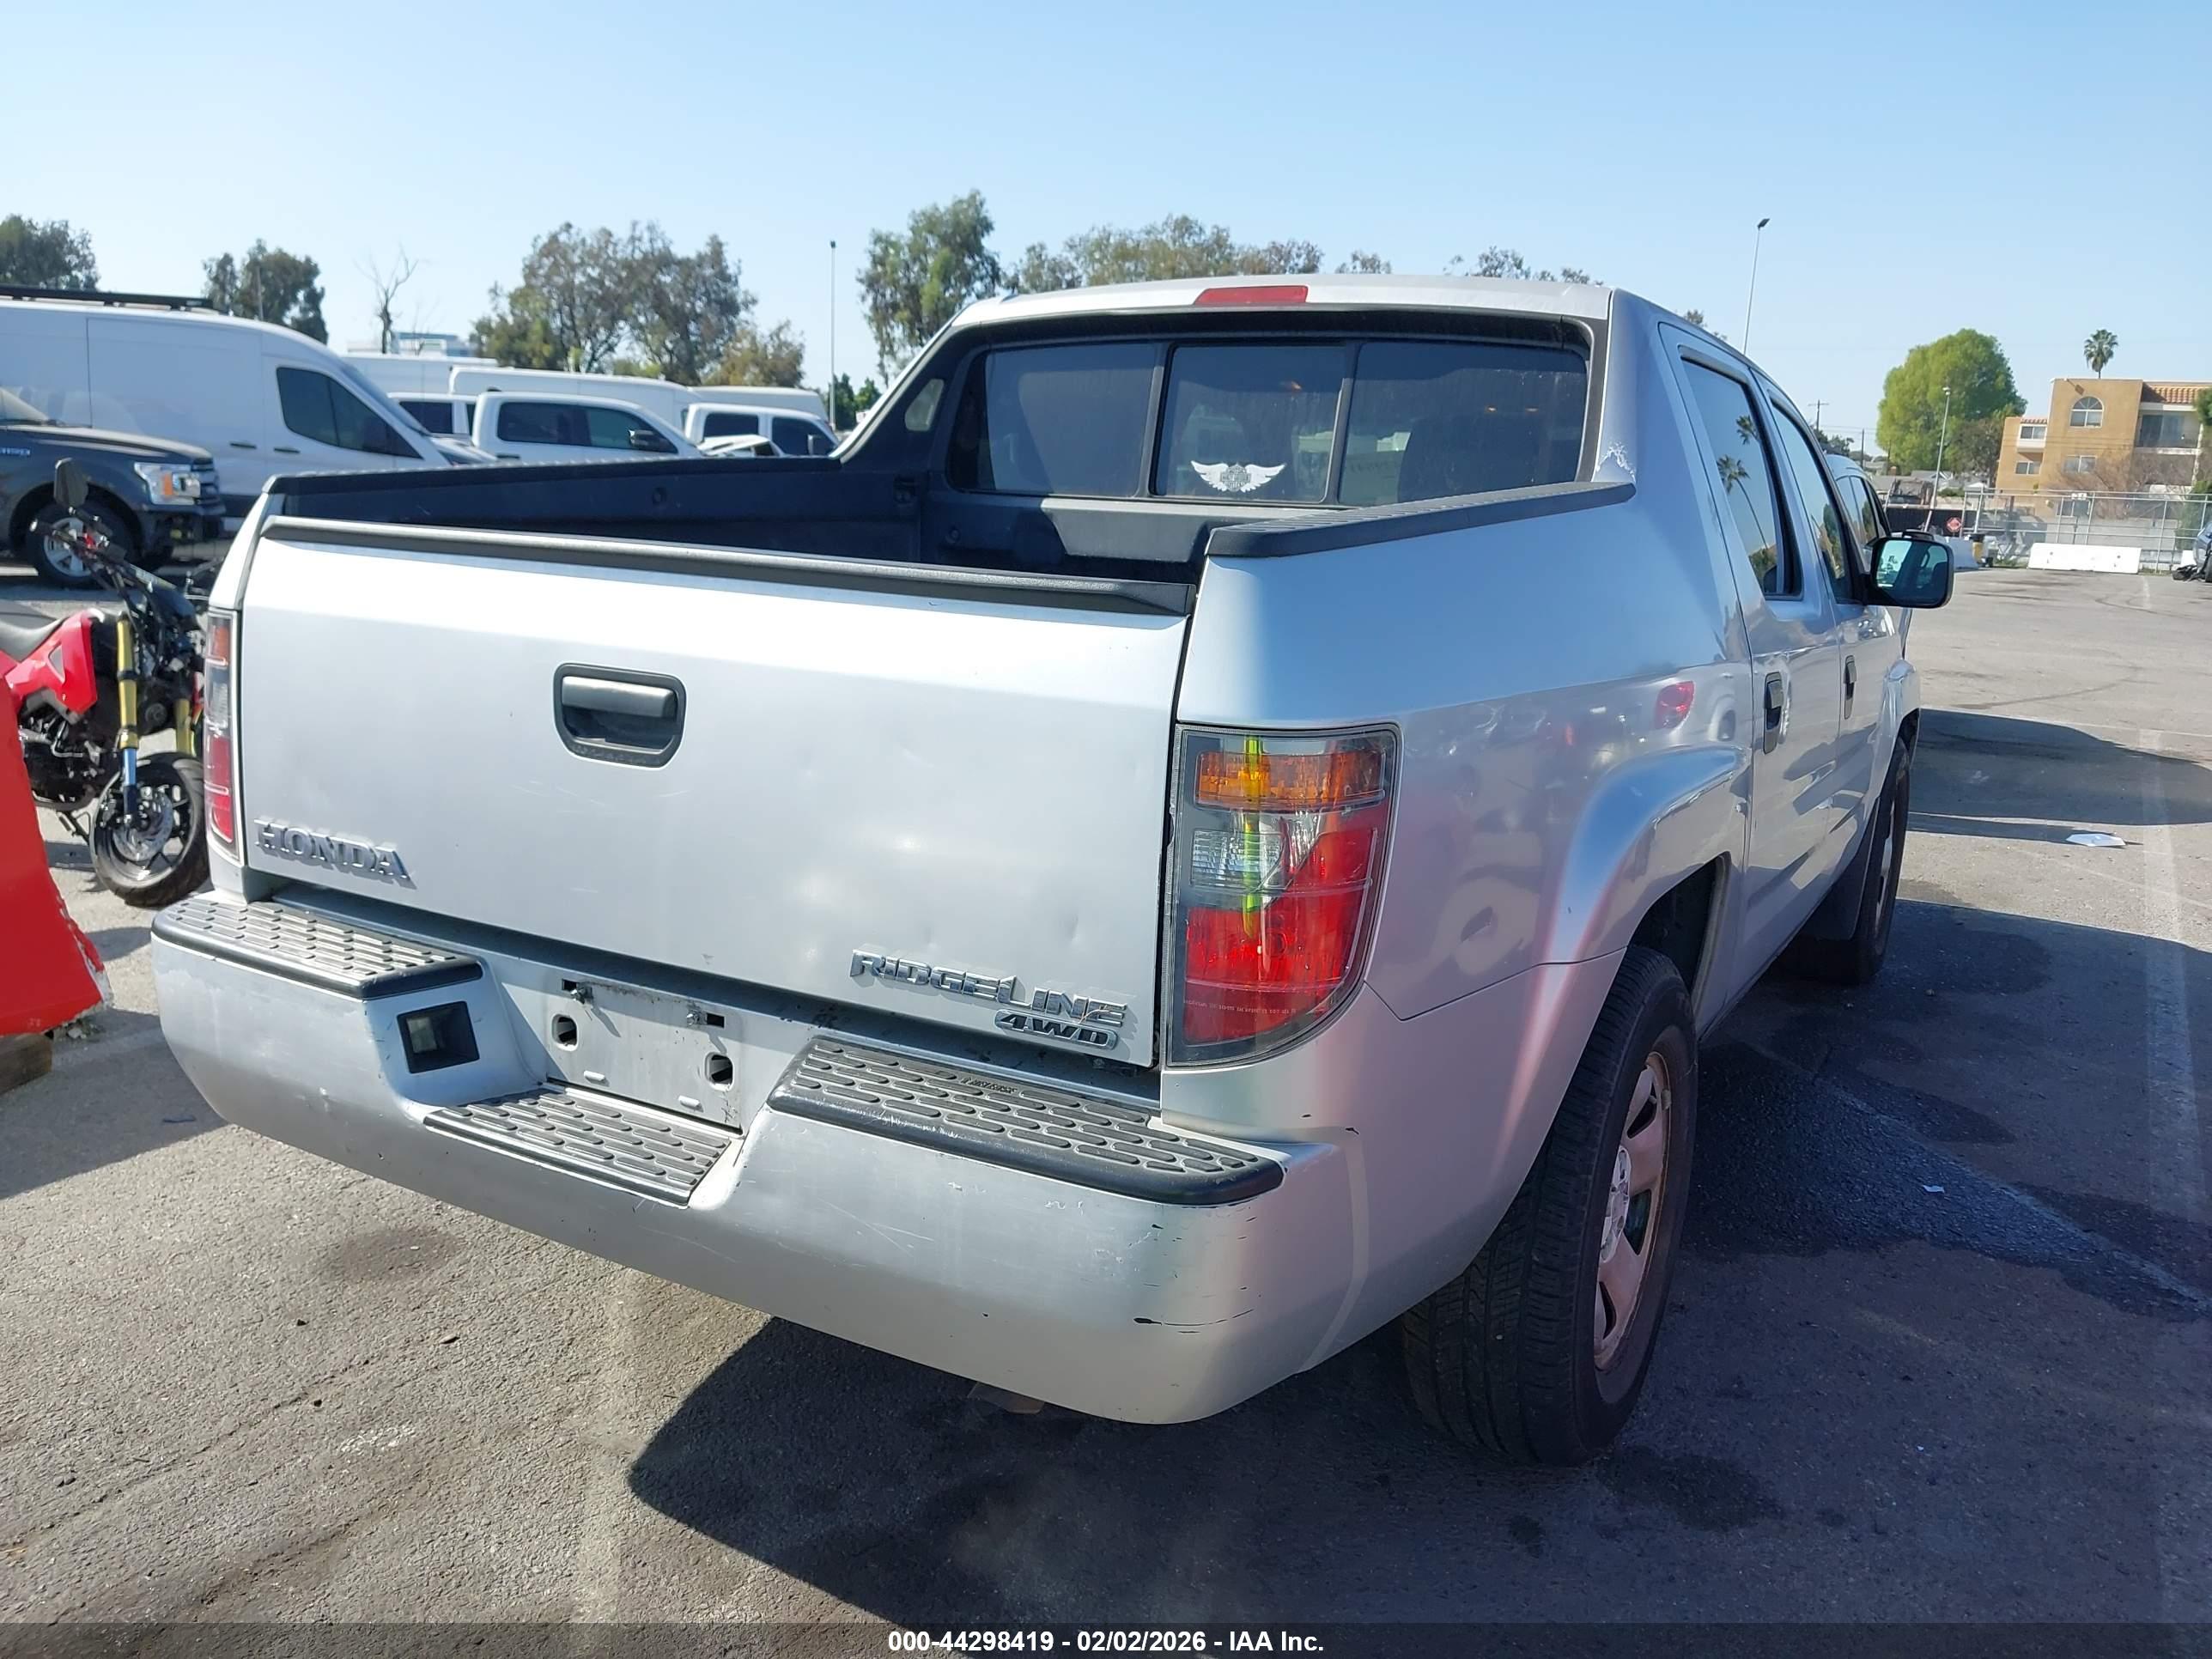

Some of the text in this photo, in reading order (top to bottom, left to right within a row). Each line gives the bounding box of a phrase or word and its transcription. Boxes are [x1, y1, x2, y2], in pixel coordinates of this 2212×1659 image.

[253, 818, 412, 882] HONDA
[850, 948, 1128, 1027] RIDGELINE
[998, 1012, 1111, 1048] 4WD
